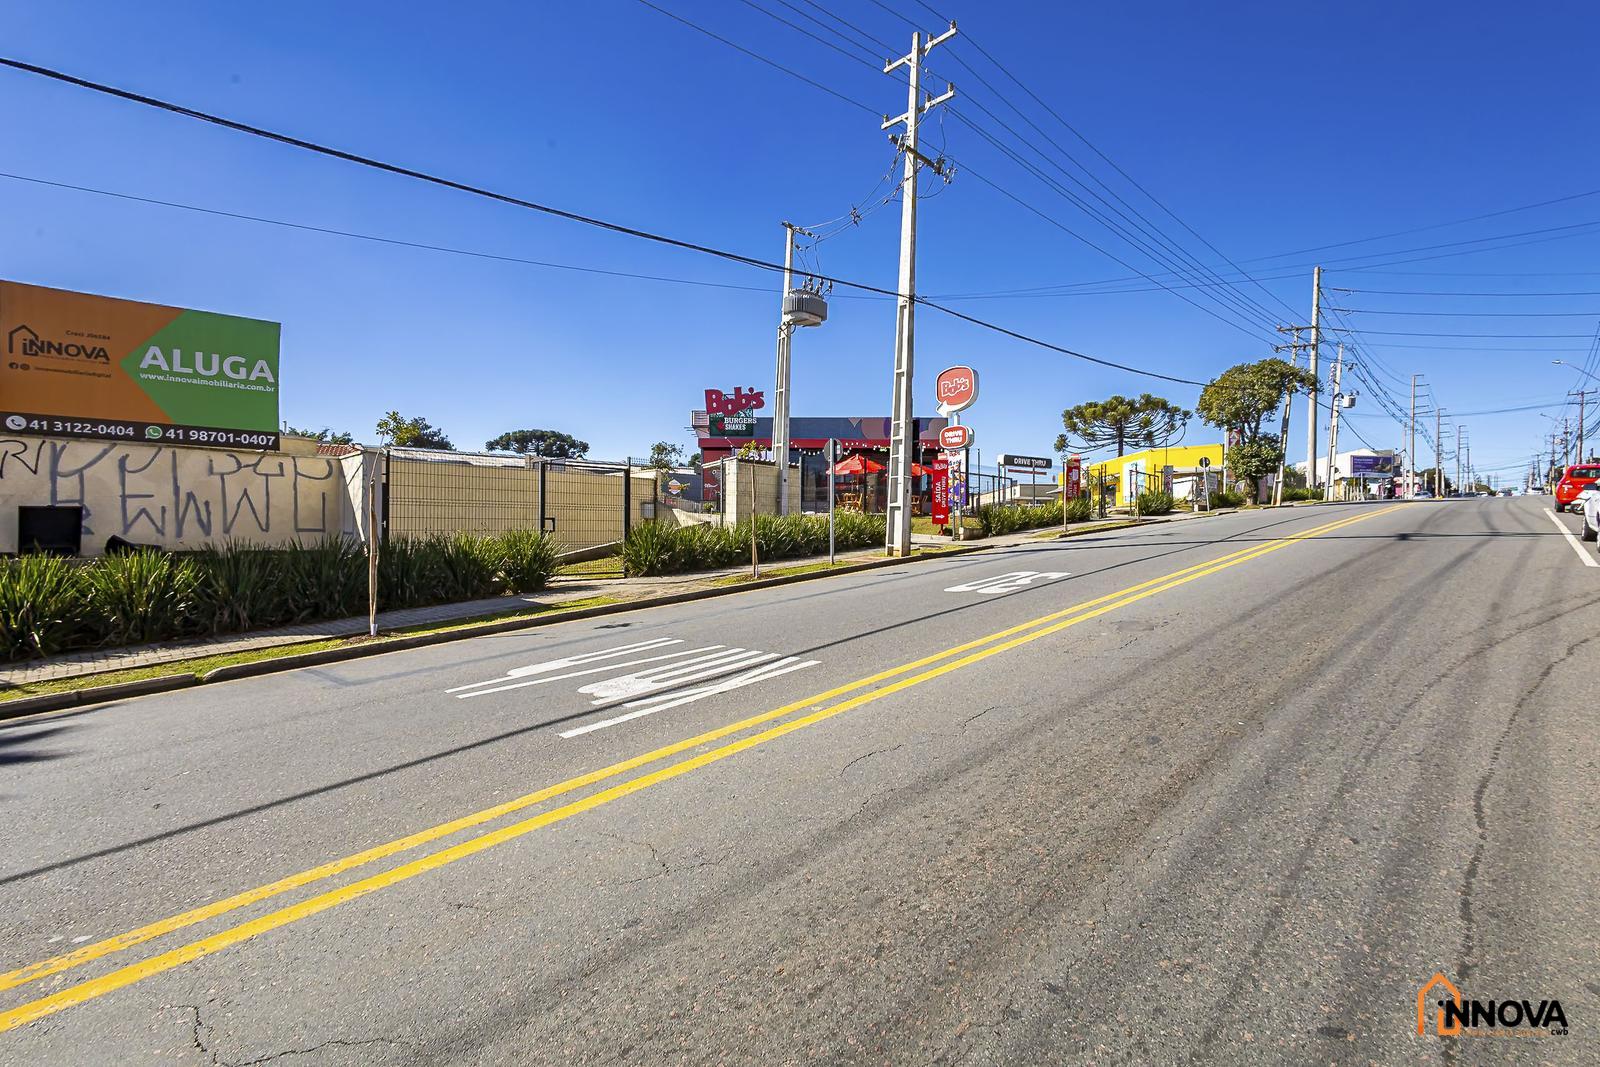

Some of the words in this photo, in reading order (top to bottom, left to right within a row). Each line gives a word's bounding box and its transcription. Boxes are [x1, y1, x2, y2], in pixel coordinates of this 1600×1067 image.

[140, 345, 275, 383] ALUGA
[139, 372, 275, 392] www.innovaimobiliaria.com.br
[941, 377, 969, 397] Bob's
[705, 386, 765, 417] Bob's
[29, 420, 48, 431] 41
[53, 421, 134, 436] 3122-0404
[725, 423, 747, 431] SHAKES
[944, 430, 963, 438] DRIVE
[166, 428, 184, 440] 41
[189, 430, 276, 446] 98701-0407
[945, 436, 963, 444] THRU
[1013, 457, 1031, 467] DRIVE
[1031, 459, 1047, 467] THRU
